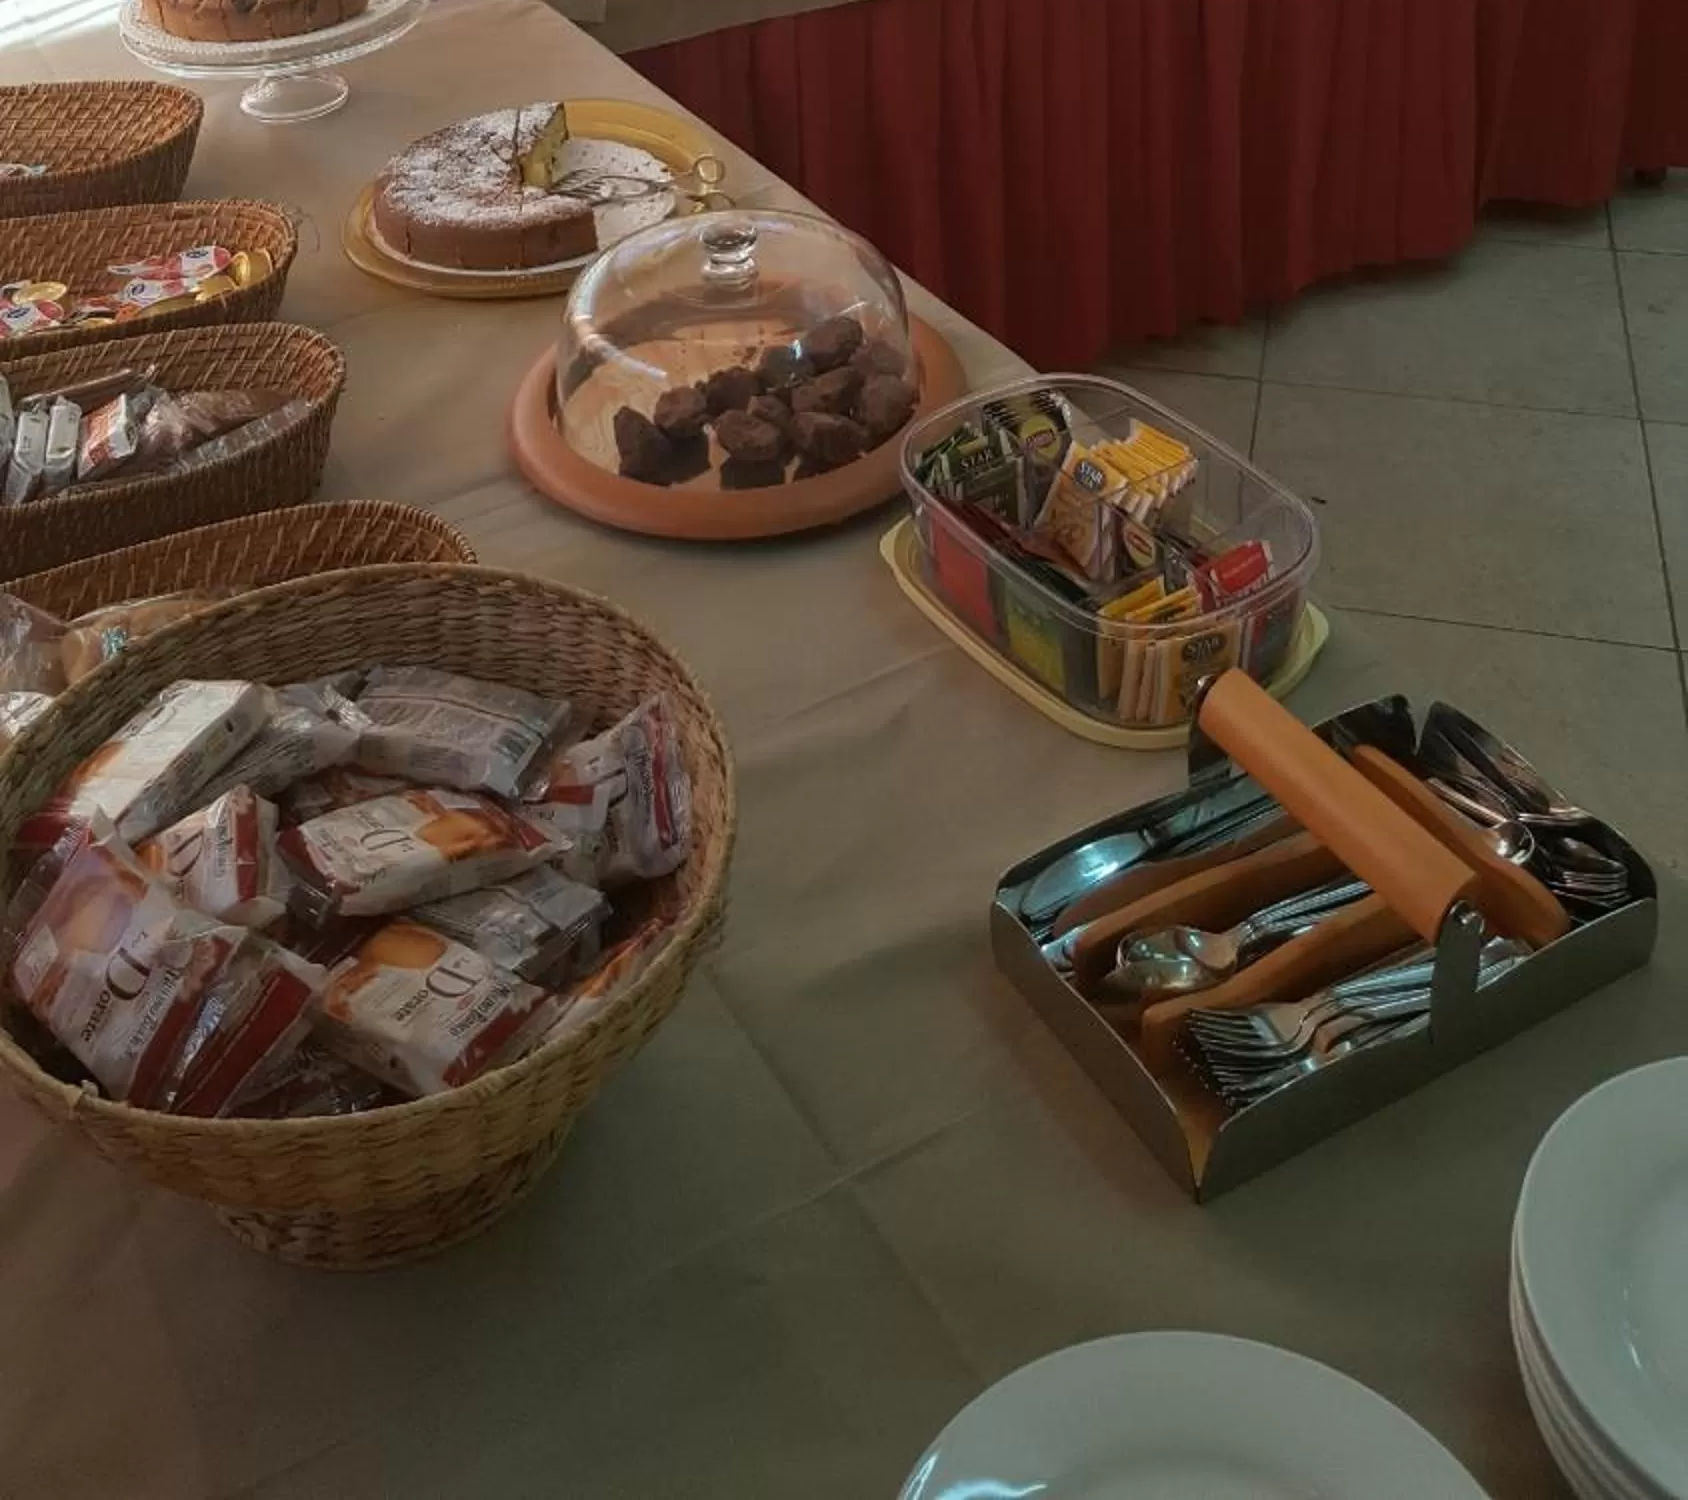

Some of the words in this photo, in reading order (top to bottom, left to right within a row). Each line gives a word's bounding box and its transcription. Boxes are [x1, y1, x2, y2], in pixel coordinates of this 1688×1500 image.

[1080, 460, 1104, 486] STAR
[79, 946, 153, 1043] Dorate
[392, 966, 479, 1022] Dorate
